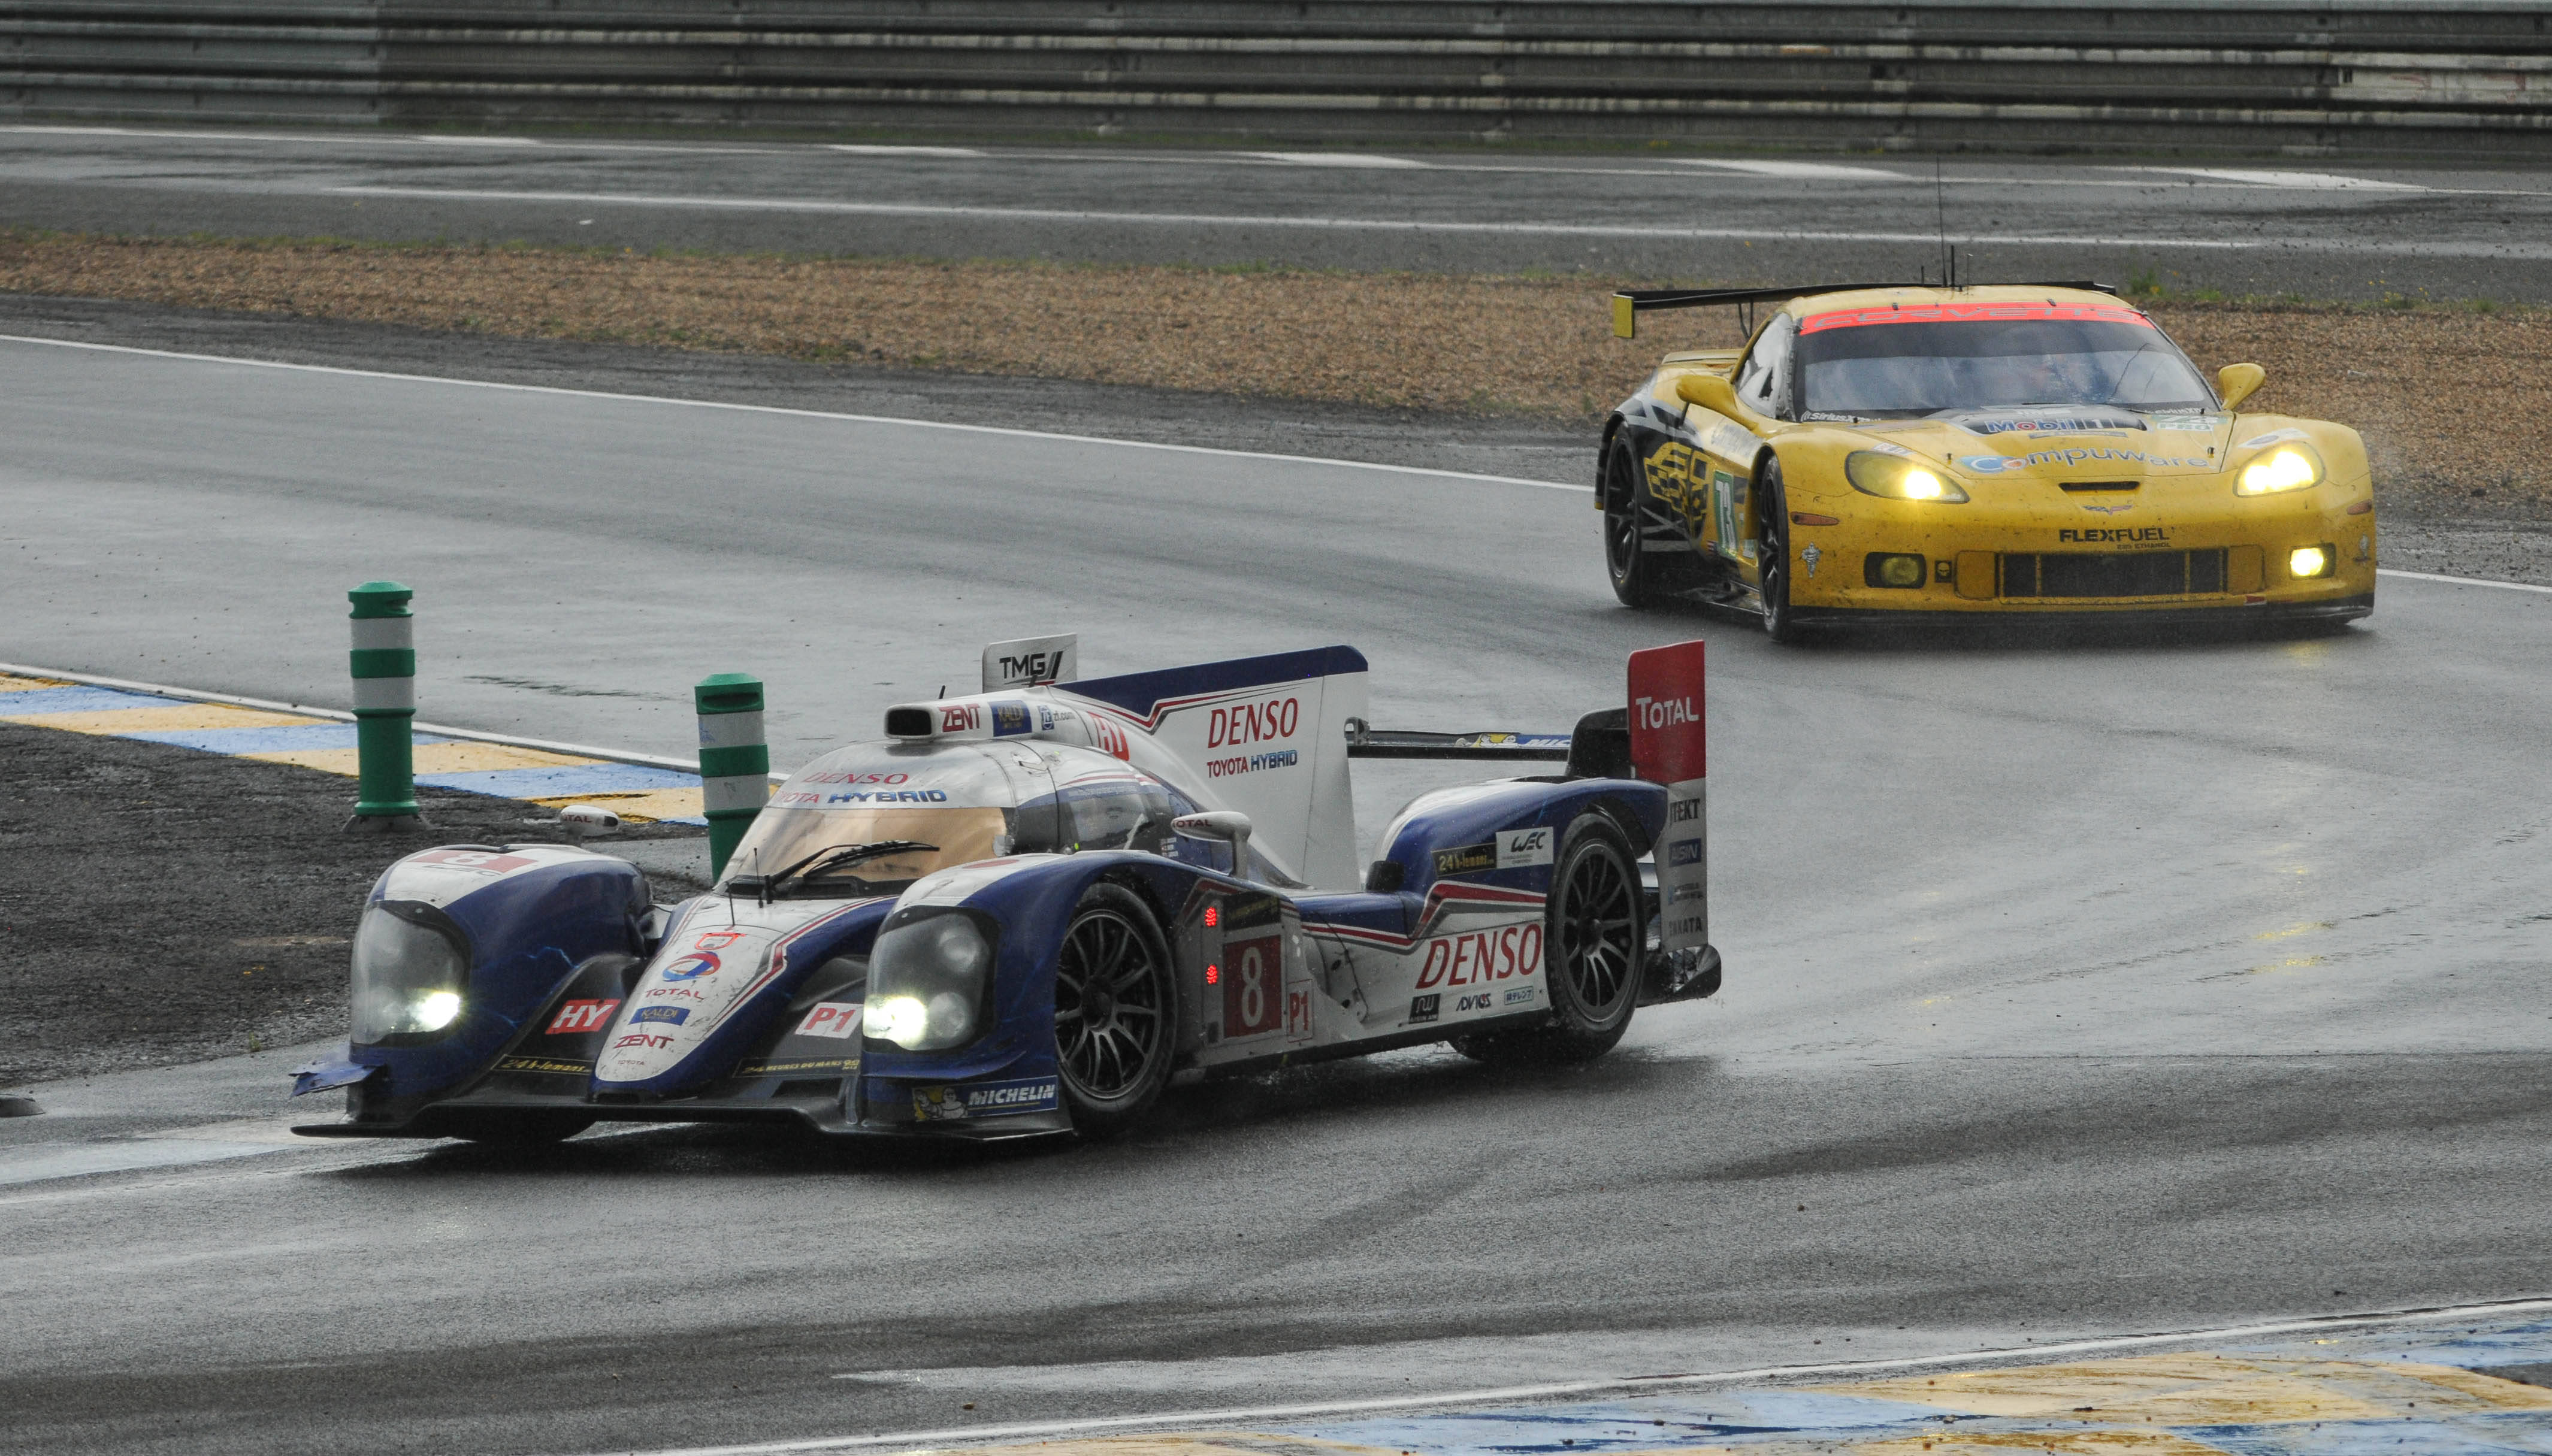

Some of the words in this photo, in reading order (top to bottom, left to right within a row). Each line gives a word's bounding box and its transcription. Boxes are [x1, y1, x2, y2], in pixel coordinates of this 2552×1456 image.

[1985, 420, 2076, 433] Mobil
[2059, 528, 2170, 542] FLEXFUEL
[999, 653, 1045, 679] TMG
[939, 704, 980, 732] ZENT
[1208, 698, 1298, 749] DENSO
[1207, 756, 1248, 778] TOYOTA
[1250, 749, 1298, 771] HYBRID
[803, 773, 909, 785] DENSO
[827, 789, 947, 803] HYBRID
[1511, 831, 1546, 852] WEC
[1414, 924, 1542, 989] DENSO
[645, 988, 704, 1001] TOTAL
[1242, 947, 1264, 1027] 8
[551, 1004, 613, 1028] HY
[805, 1007, 857, 1031] P1
[1289, 991, 1308, 1033] P1
[613, 1034, 675, 1049] ZENT
[968, 1084, 1056, 1106] MICHELIN
